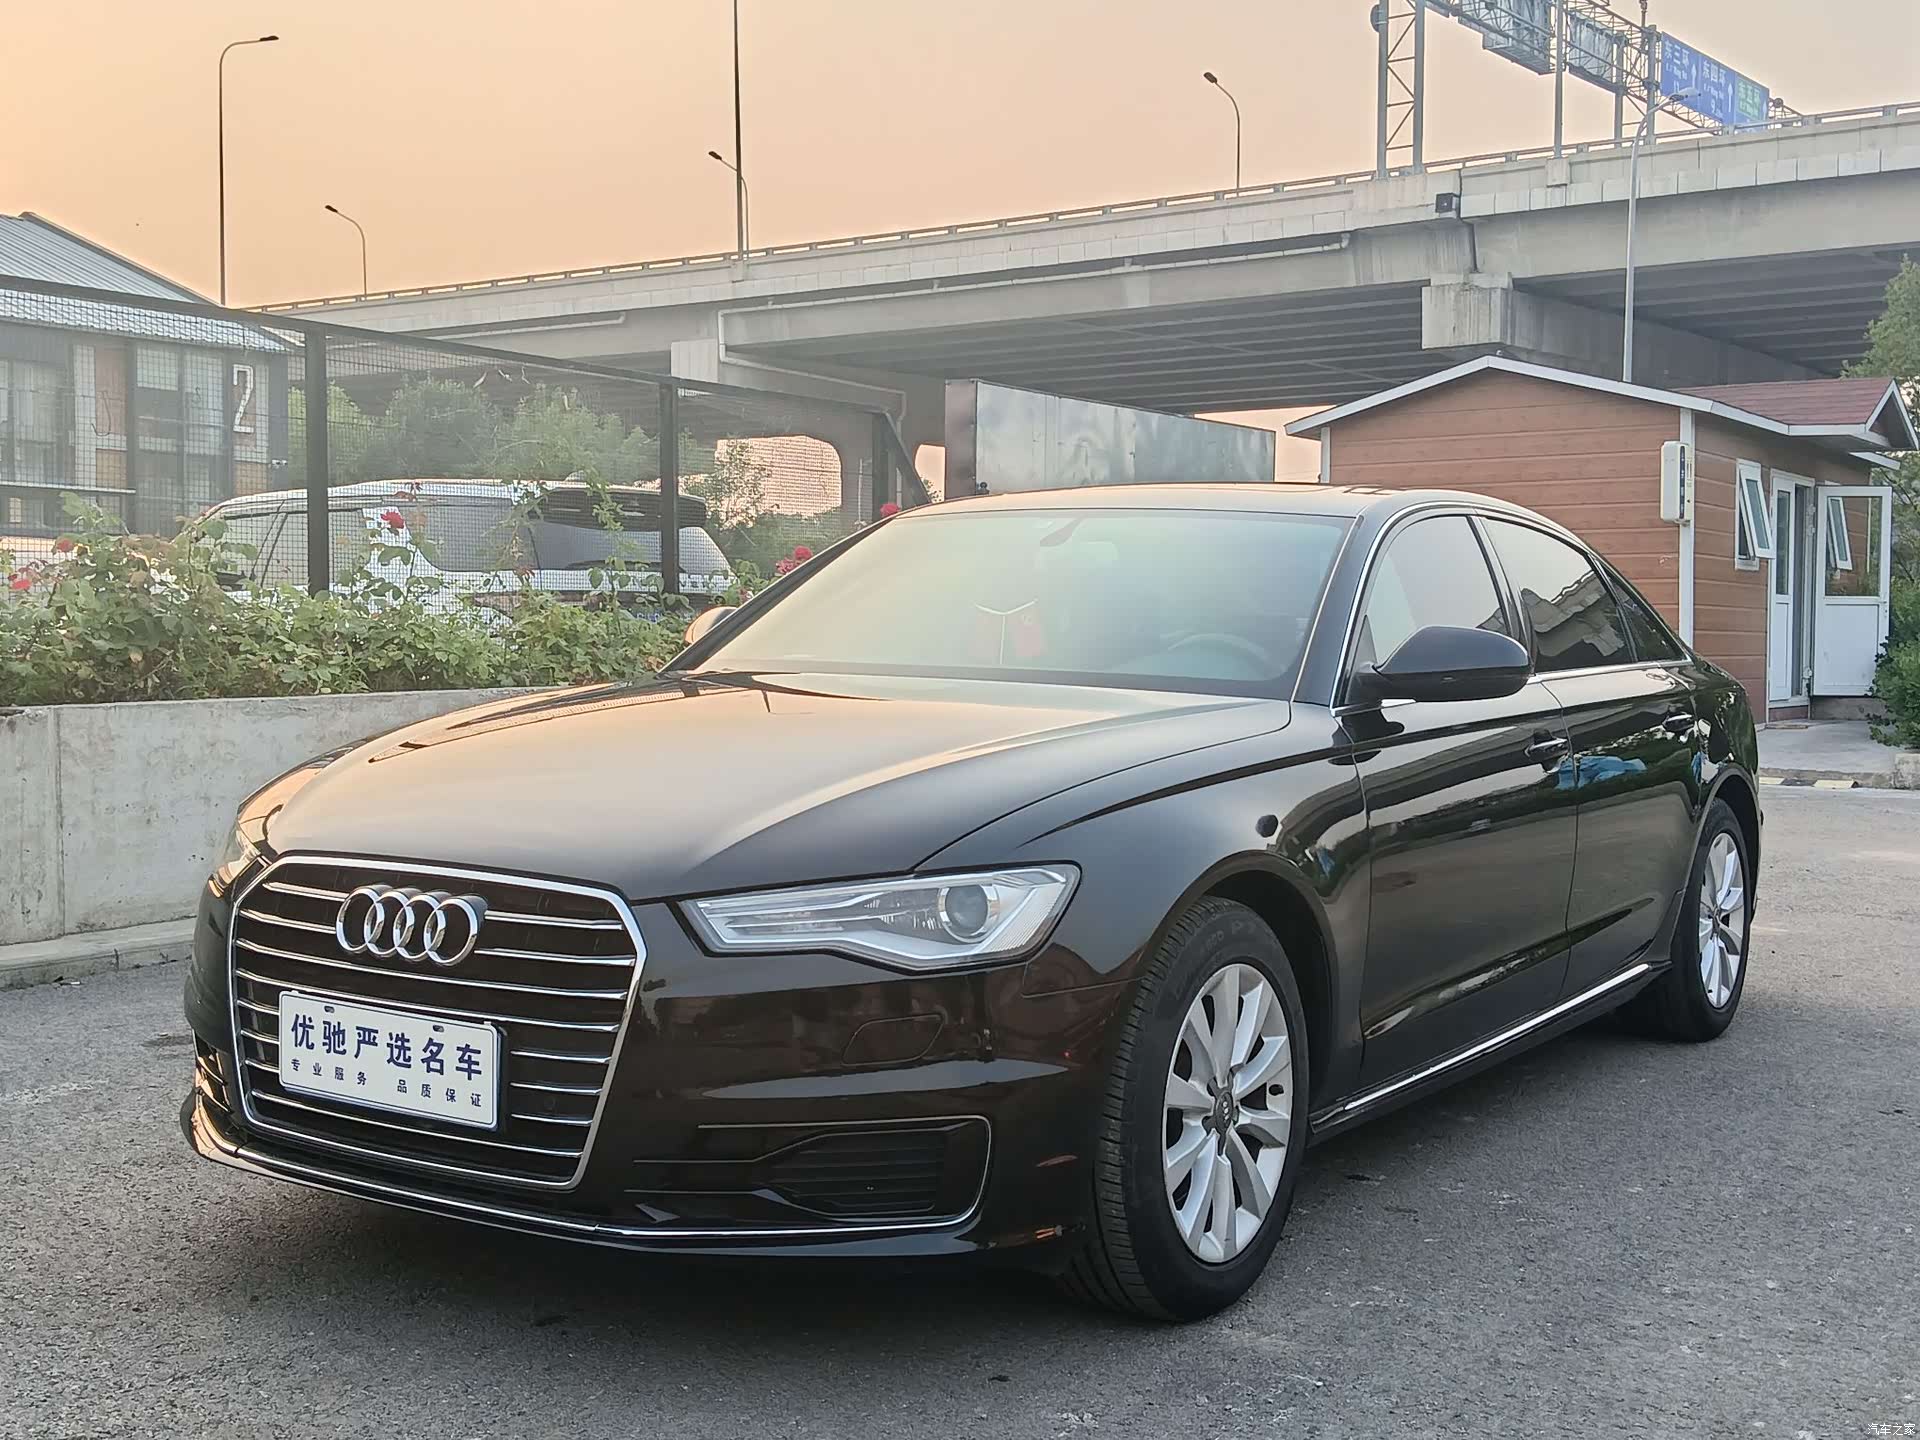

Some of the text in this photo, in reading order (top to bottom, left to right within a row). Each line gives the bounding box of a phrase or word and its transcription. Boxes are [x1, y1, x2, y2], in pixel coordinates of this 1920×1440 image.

[1664, 40, 1690, 69] 东三环
[1703, 60, 1727, 88] 东四环
[233, 363, 255, 433] 2
[291, 1013, 482, 1081] 优驰严选名车
[291, 1058, 482, 1108] 专业服务 品质保证
